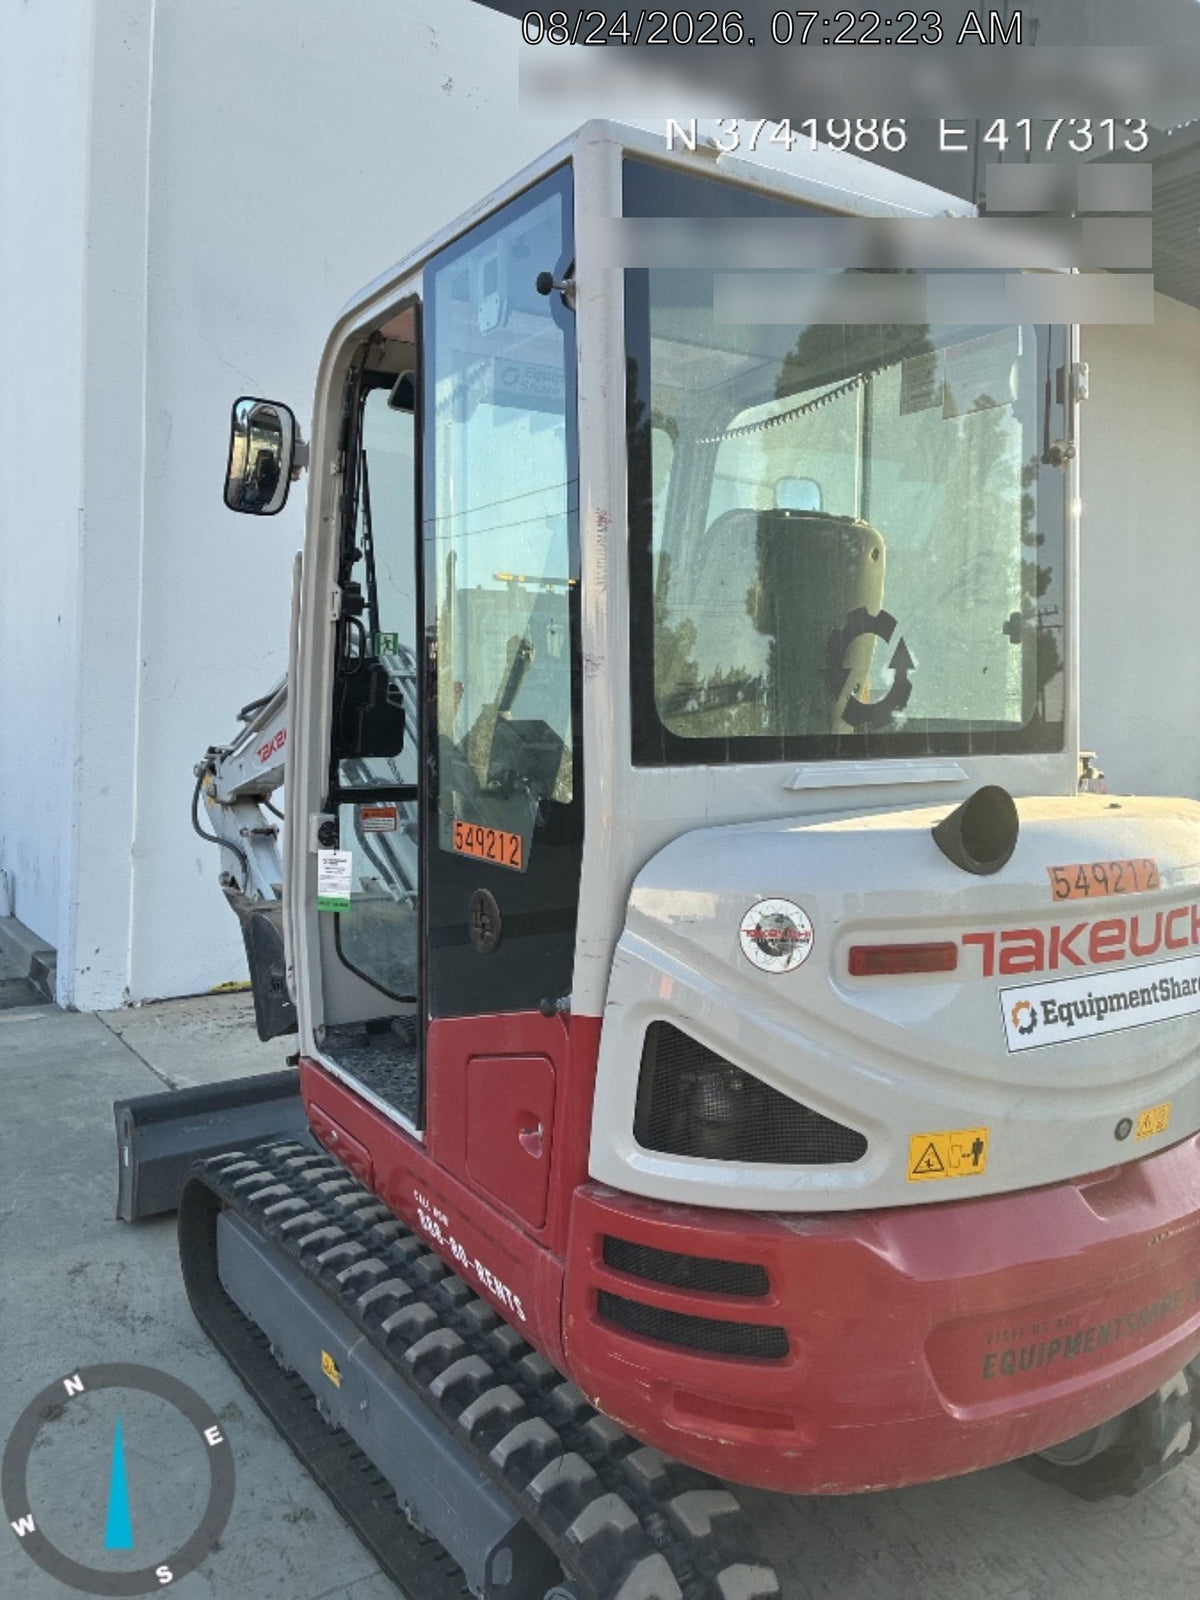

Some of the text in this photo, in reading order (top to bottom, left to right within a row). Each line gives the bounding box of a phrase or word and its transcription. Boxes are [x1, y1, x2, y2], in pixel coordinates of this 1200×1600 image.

[256, 727, 287, 764] TAKE
[455, 822, 520, 866] 549212
[1052, 858, 1160, 899] 549212
